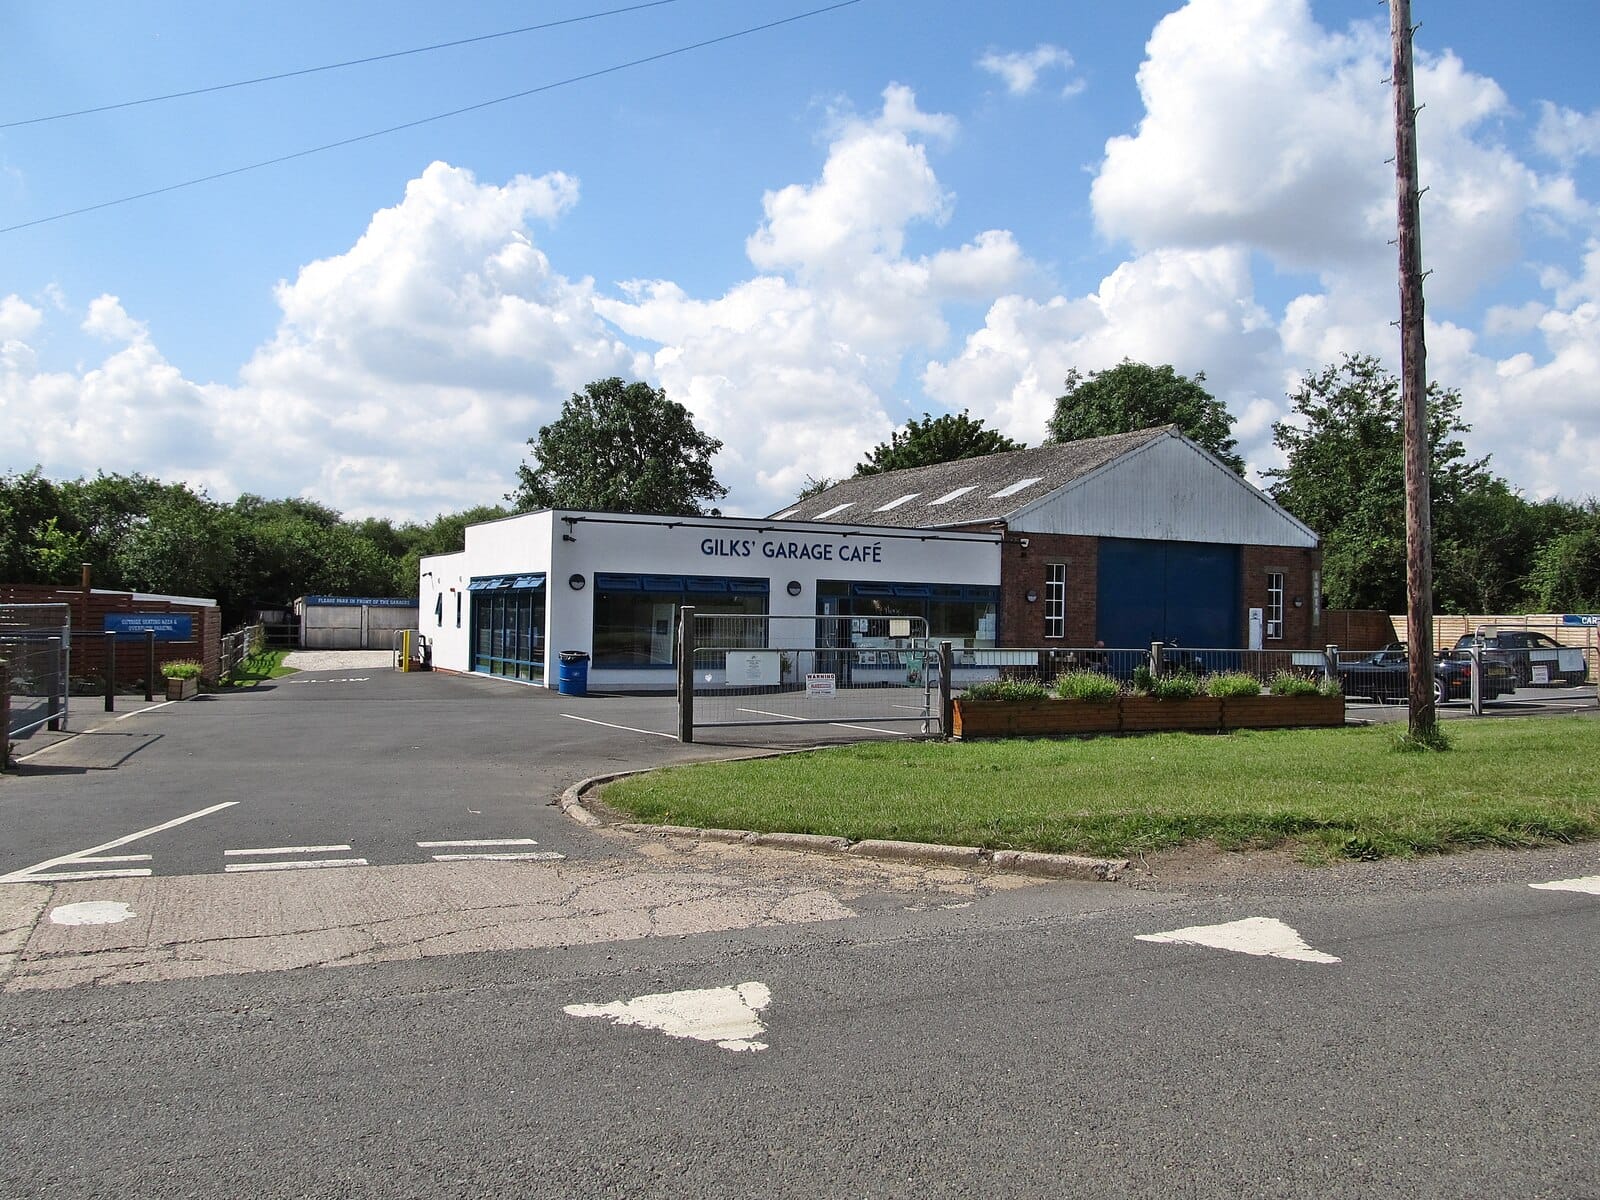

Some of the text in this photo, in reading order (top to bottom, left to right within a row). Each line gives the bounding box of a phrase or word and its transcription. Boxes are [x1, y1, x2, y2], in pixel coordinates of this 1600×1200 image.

[762, 541, 833, 561] GARAGE
[838, 541, 882, 563] CAFÉ
[1581, 616, 1598, 625] CAR
